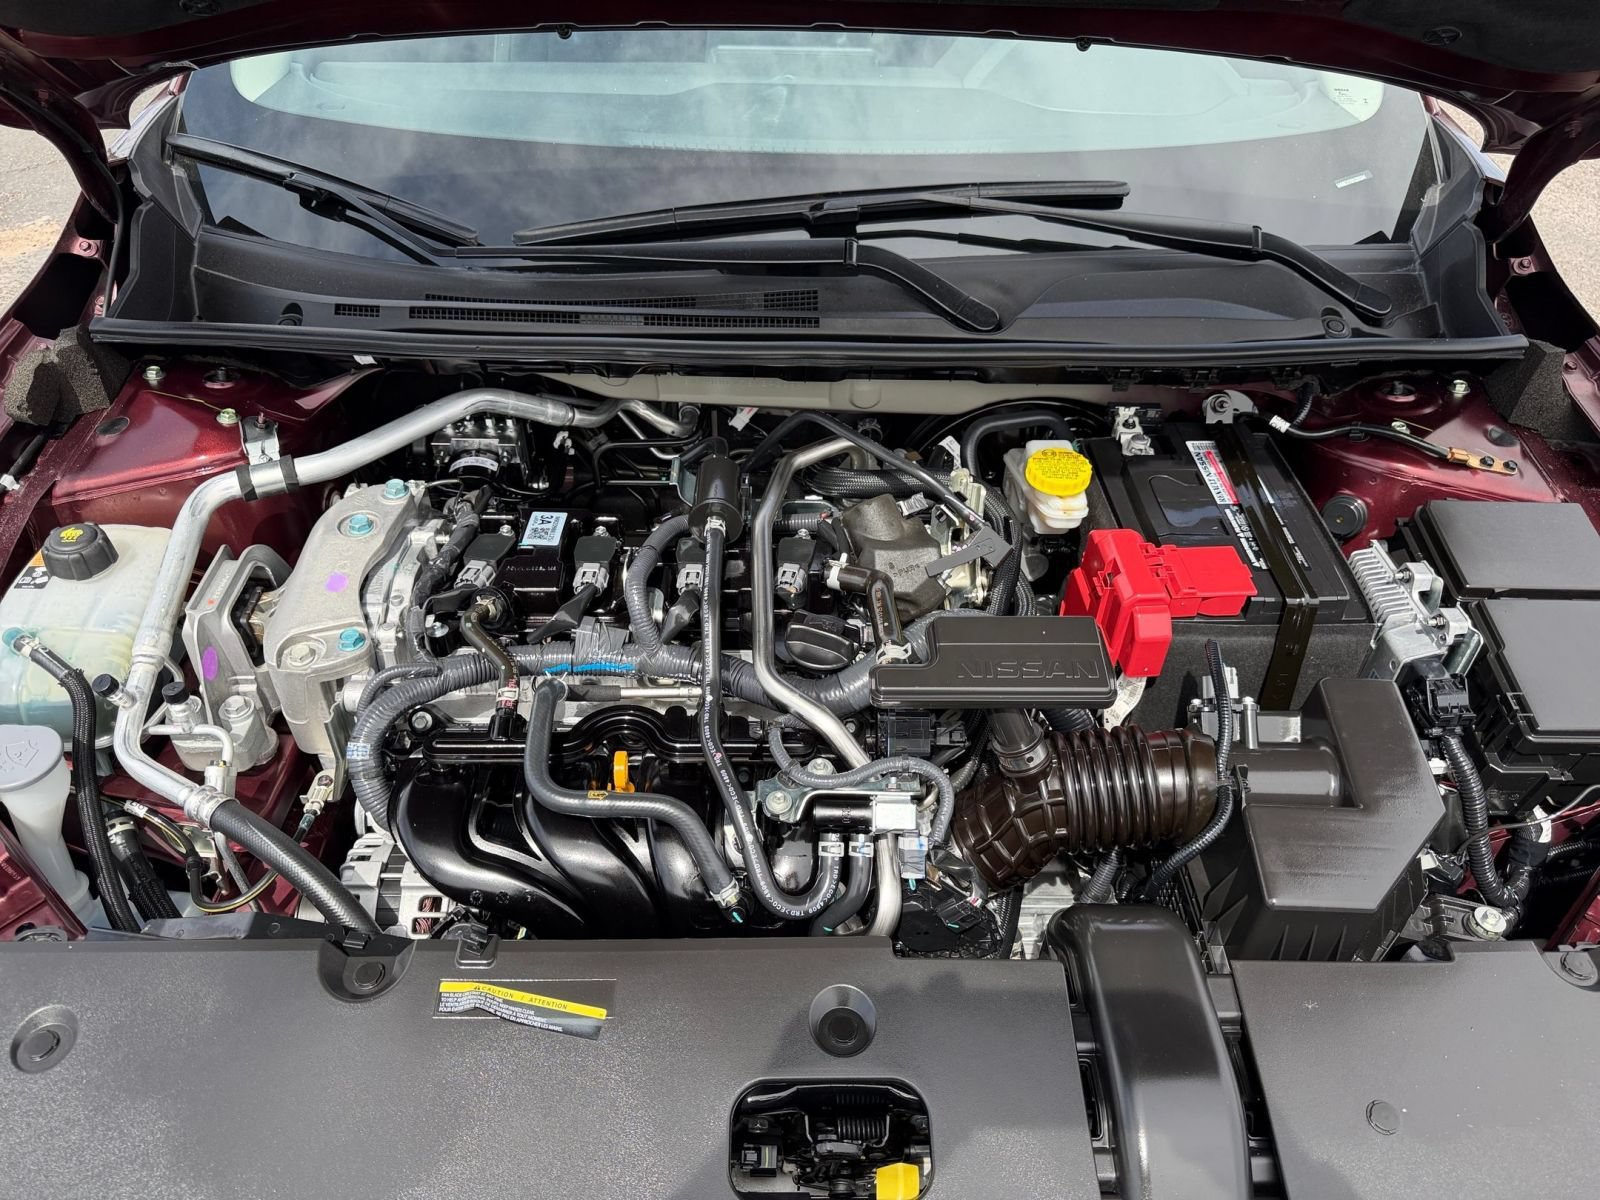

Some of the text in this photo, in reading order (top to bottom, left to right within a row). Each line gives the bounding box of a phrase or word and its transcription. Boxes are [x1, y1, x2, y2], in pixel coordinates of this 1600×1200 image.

[538, 514, 554, 526] 3A
[957, 660, 1100, 679] NISSAN
[481, 986, 514, 999] CAUTION
[529, 997, 568, 1010] ATTENTION
